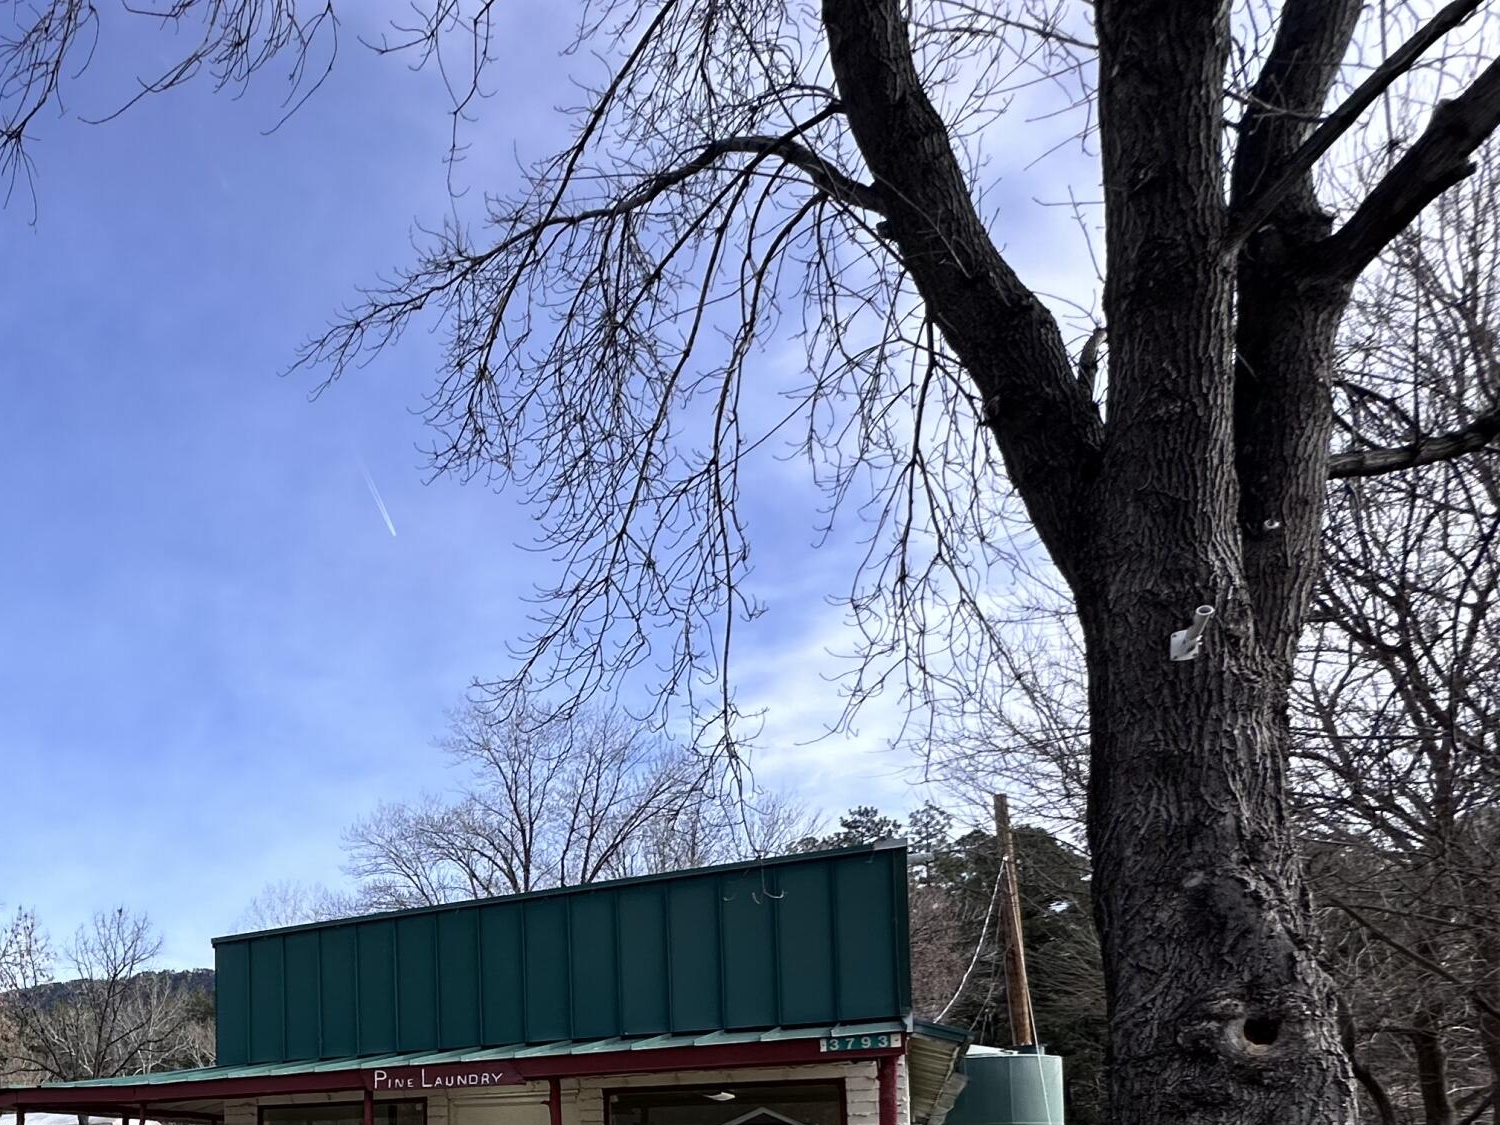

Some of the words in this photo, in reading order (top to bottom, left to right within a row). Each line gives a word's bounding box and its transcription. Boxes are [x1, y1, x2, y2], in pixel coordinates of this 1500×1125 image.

[829, 1035, 888, 1051] 3793
[374, 1070, 414, 1089] PINE
[421, 1068, 503, 1087] LAUNDRY
